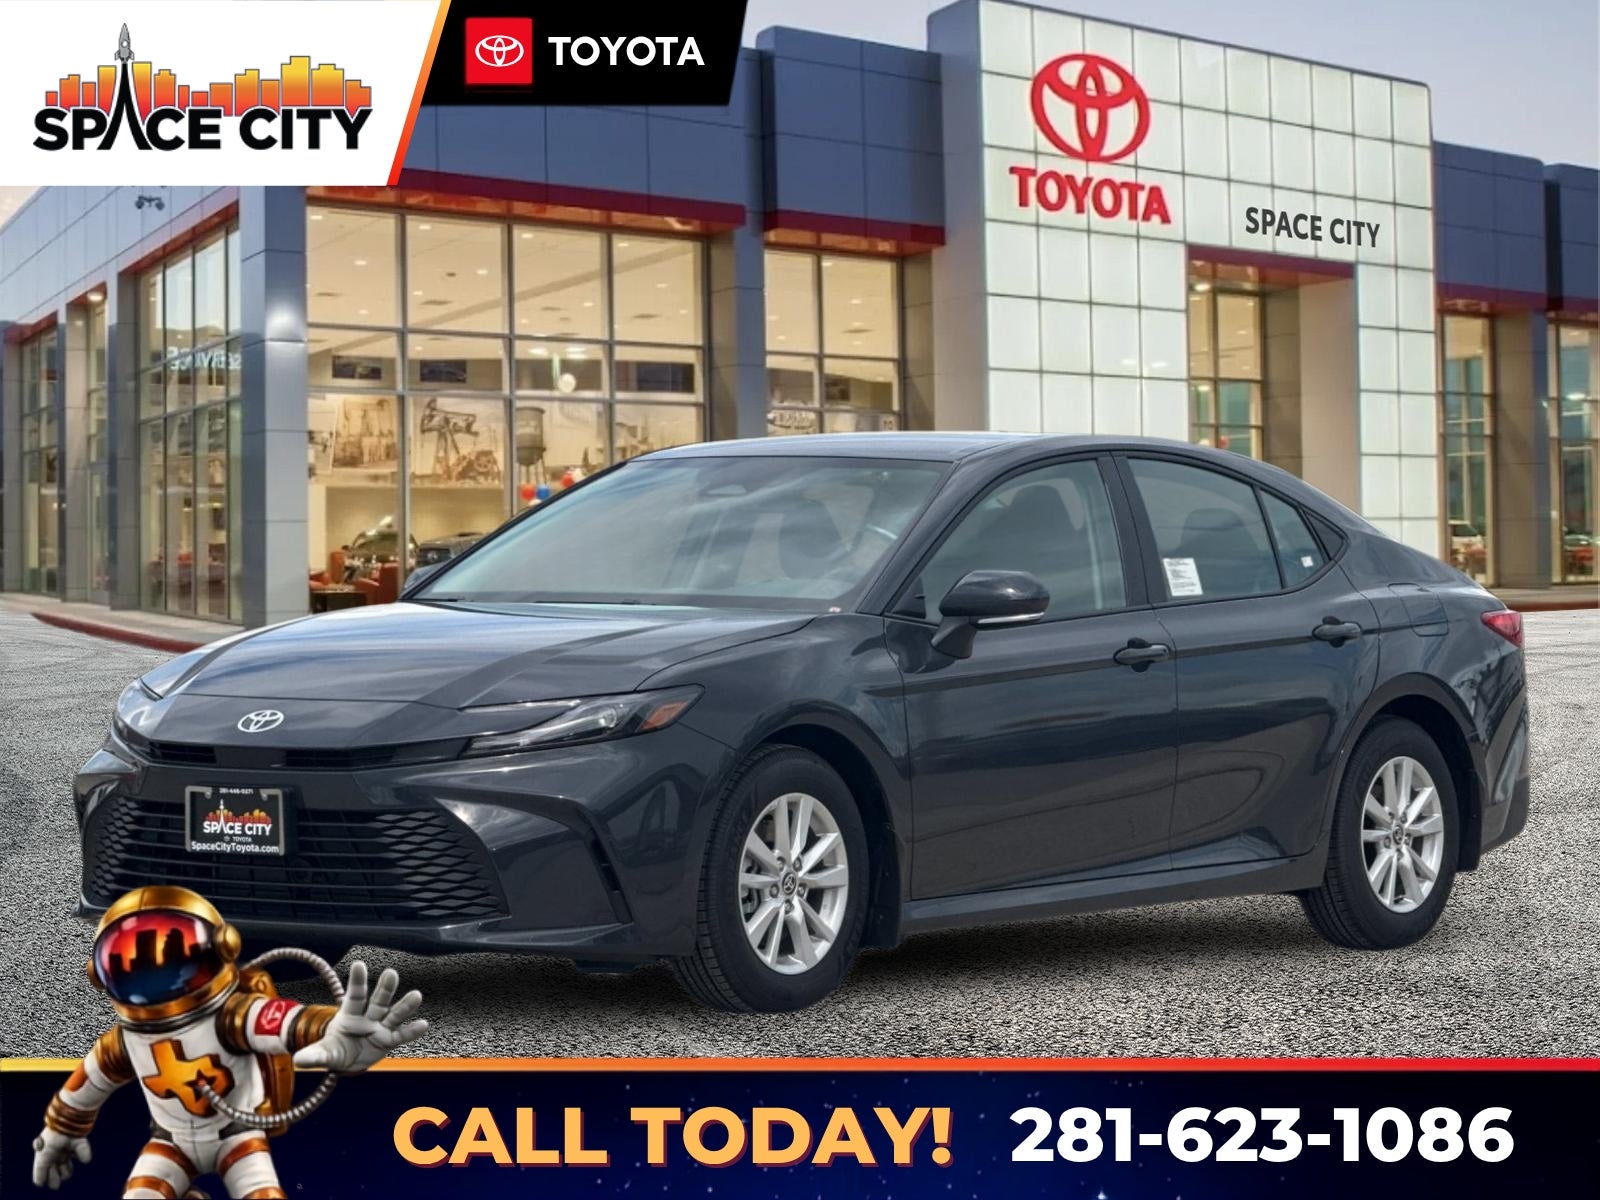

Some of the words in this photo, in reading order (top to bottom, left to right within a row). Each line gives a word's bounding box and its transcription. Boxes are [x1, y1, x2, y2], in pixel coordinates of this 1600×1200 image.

[1010, 165, 1171, 224] TOYOTA
[1244, 206, 1322, 242] SPACE
[1329, 217, 1381, 249] CITY
[203, 820, 242, 835] SPACE
[244, 823, 272, 837] CITY
[191, 840, 280, 854] SpaceCityToyota.com
